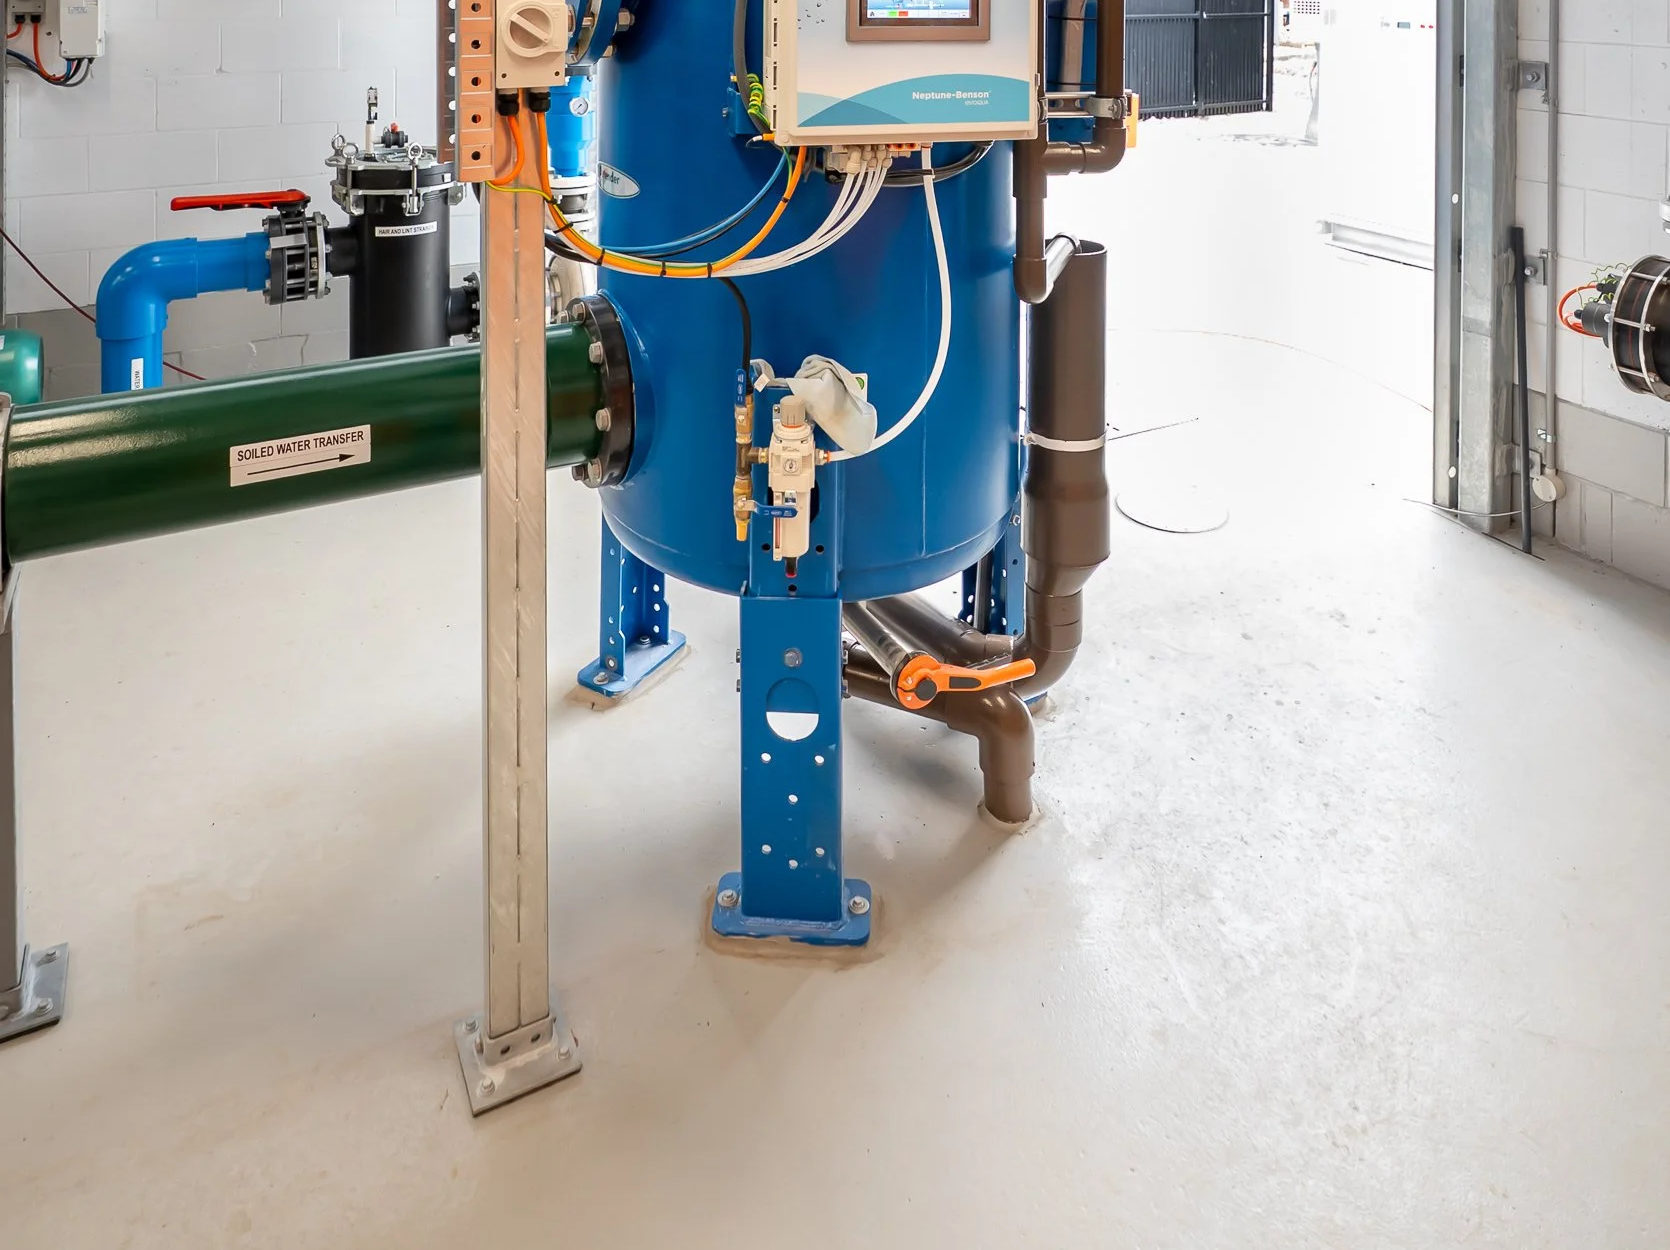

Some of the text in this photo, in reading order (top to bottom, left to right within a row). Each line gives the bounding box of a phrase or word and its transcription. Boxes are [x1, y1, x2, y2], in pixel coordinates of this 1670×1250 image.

[912, 90, 989, 100] Neptune-Benson
[237, 430, 364, 462] SOILED WATER TRANSFER
